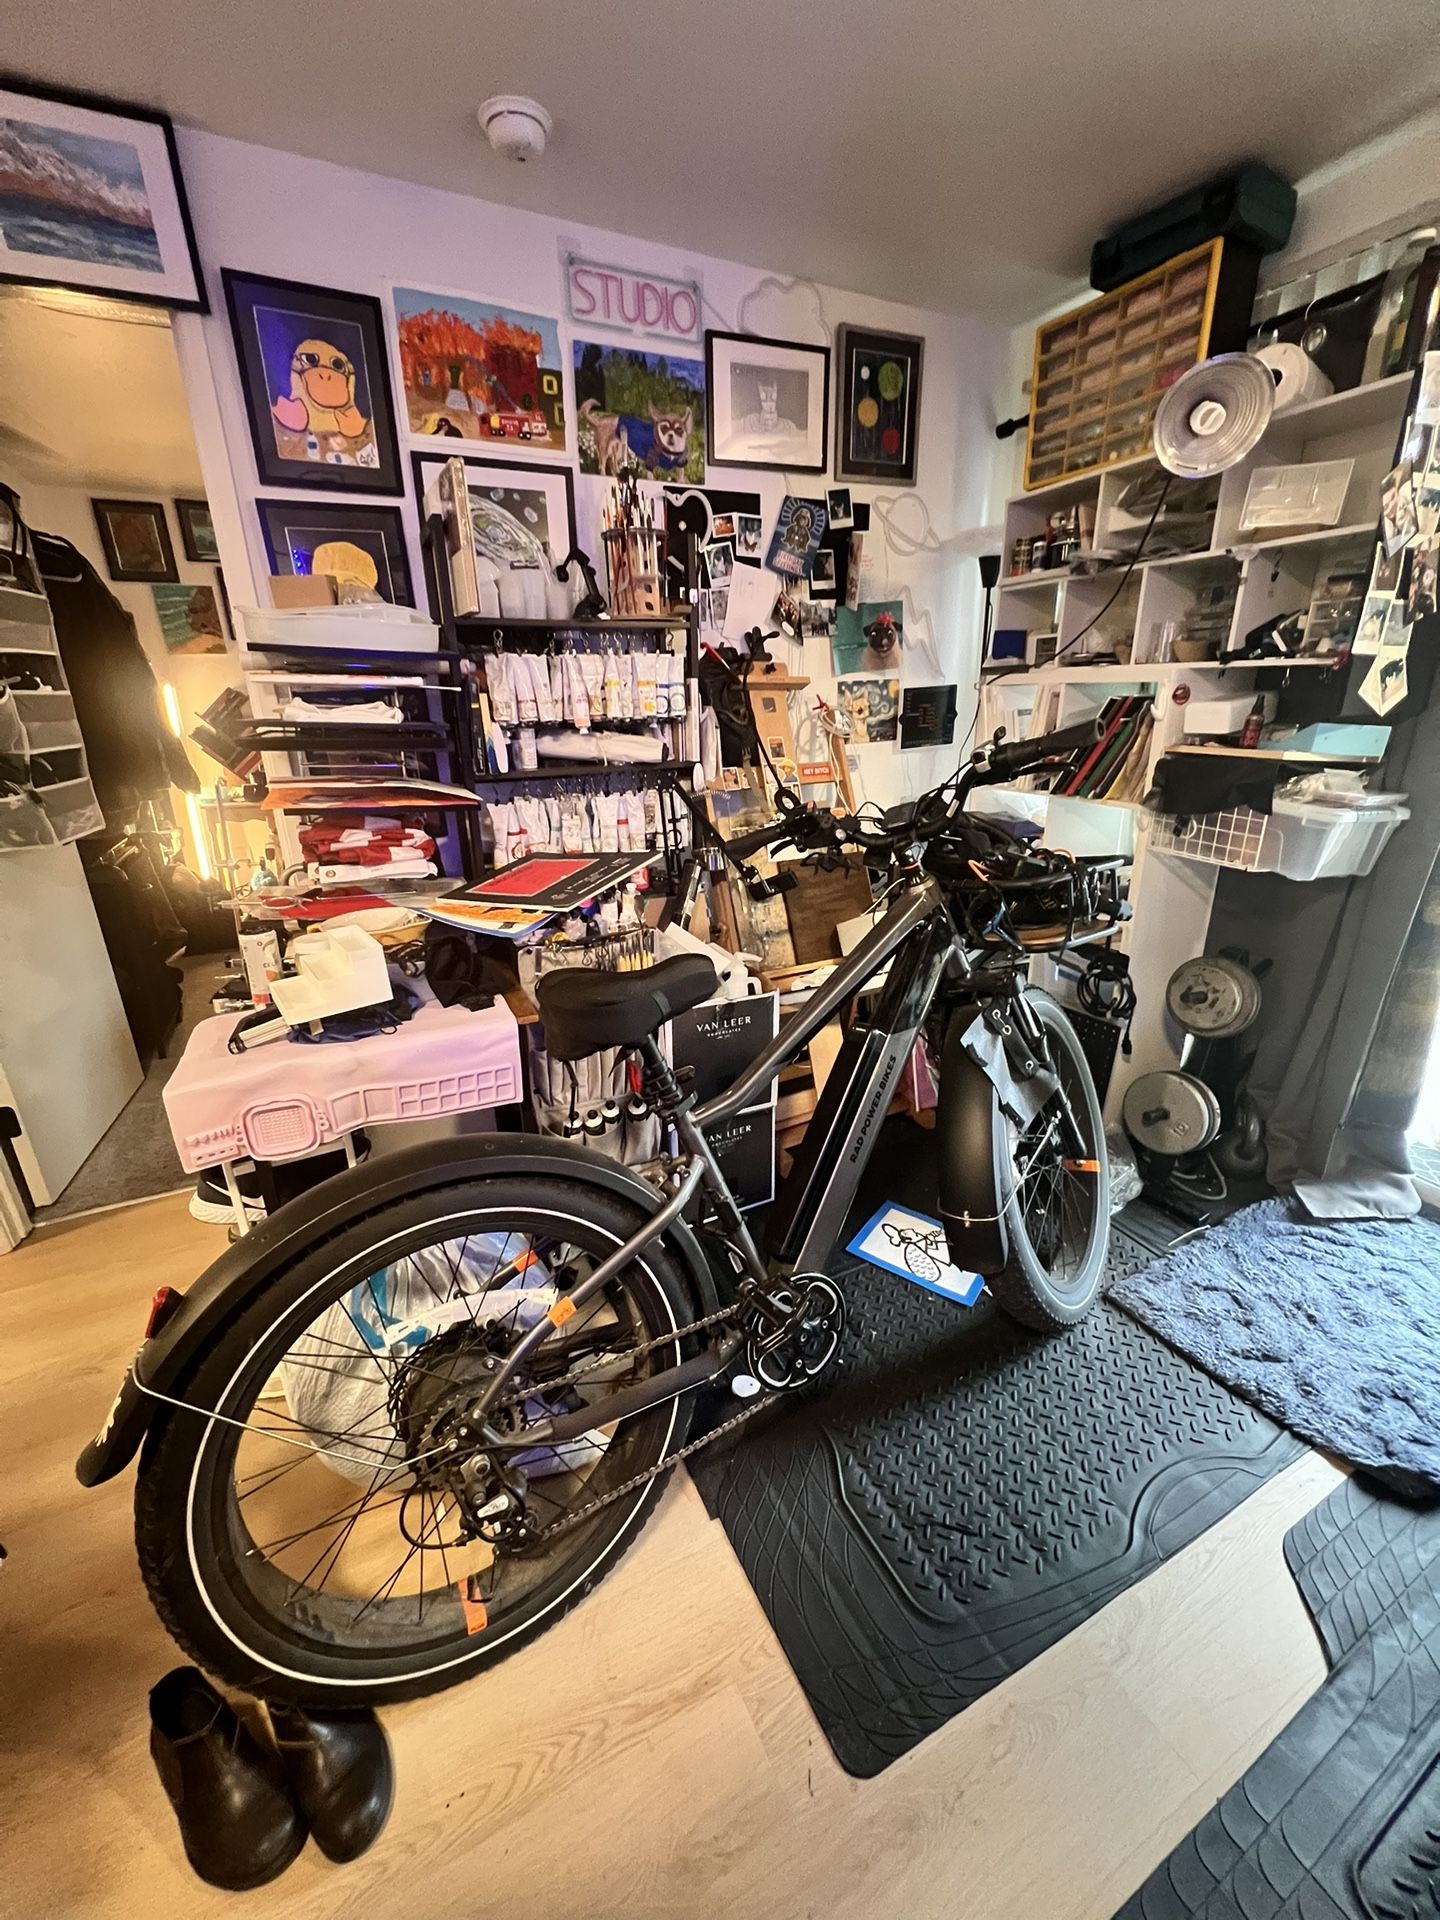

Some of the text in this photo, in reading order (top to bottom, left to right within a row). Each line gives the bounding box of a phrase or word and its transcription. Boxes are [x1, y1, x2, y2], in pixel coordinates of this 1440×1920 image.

[573, 269, 697, 335] STUDIO
[696, 1015, 752, 1032] VAN LEER
[849, 1054, 897, 1163] RAD POWER BIKES
[705, 1132, 722, 1142] AN
[726, 1124, 752, 1138] LEER
